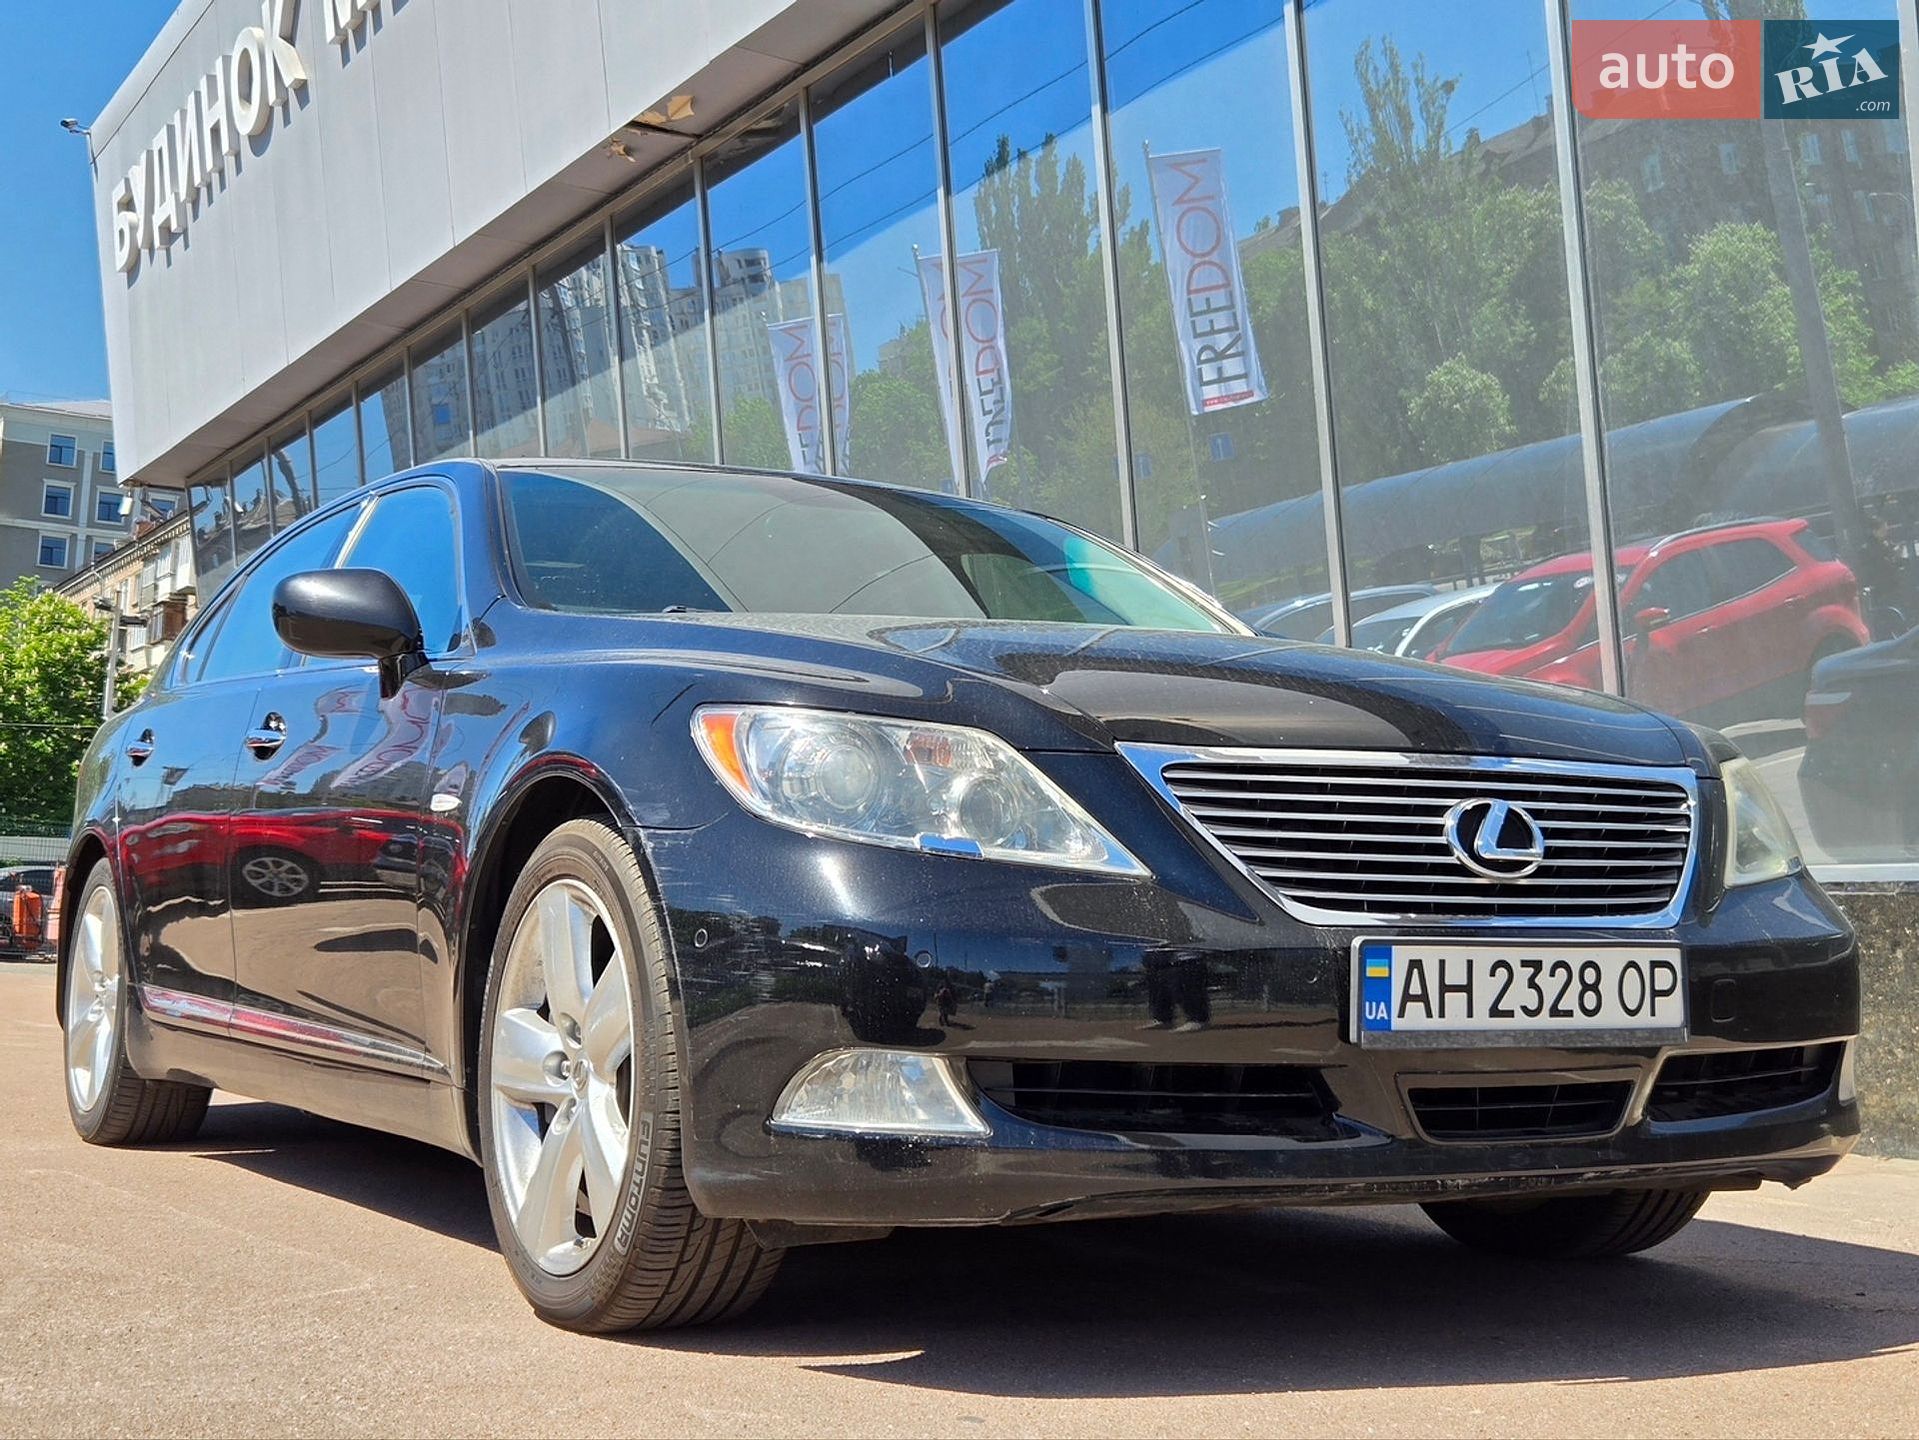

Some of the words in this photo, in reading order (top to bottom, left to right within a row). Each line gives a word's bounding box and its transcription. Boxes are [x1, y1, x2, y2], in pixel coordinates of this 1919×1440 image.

[112, 0, 307, 272] БУДИНОК
[1169, 158, 1248, 386] FREEDOM
[1365, 1001, 1388, 1020] UA
[1397, 958, 1474, 1019] AH
[1488, 959, 1602, 1018] 2328
[1617, 960, 1678, 1017] OP
